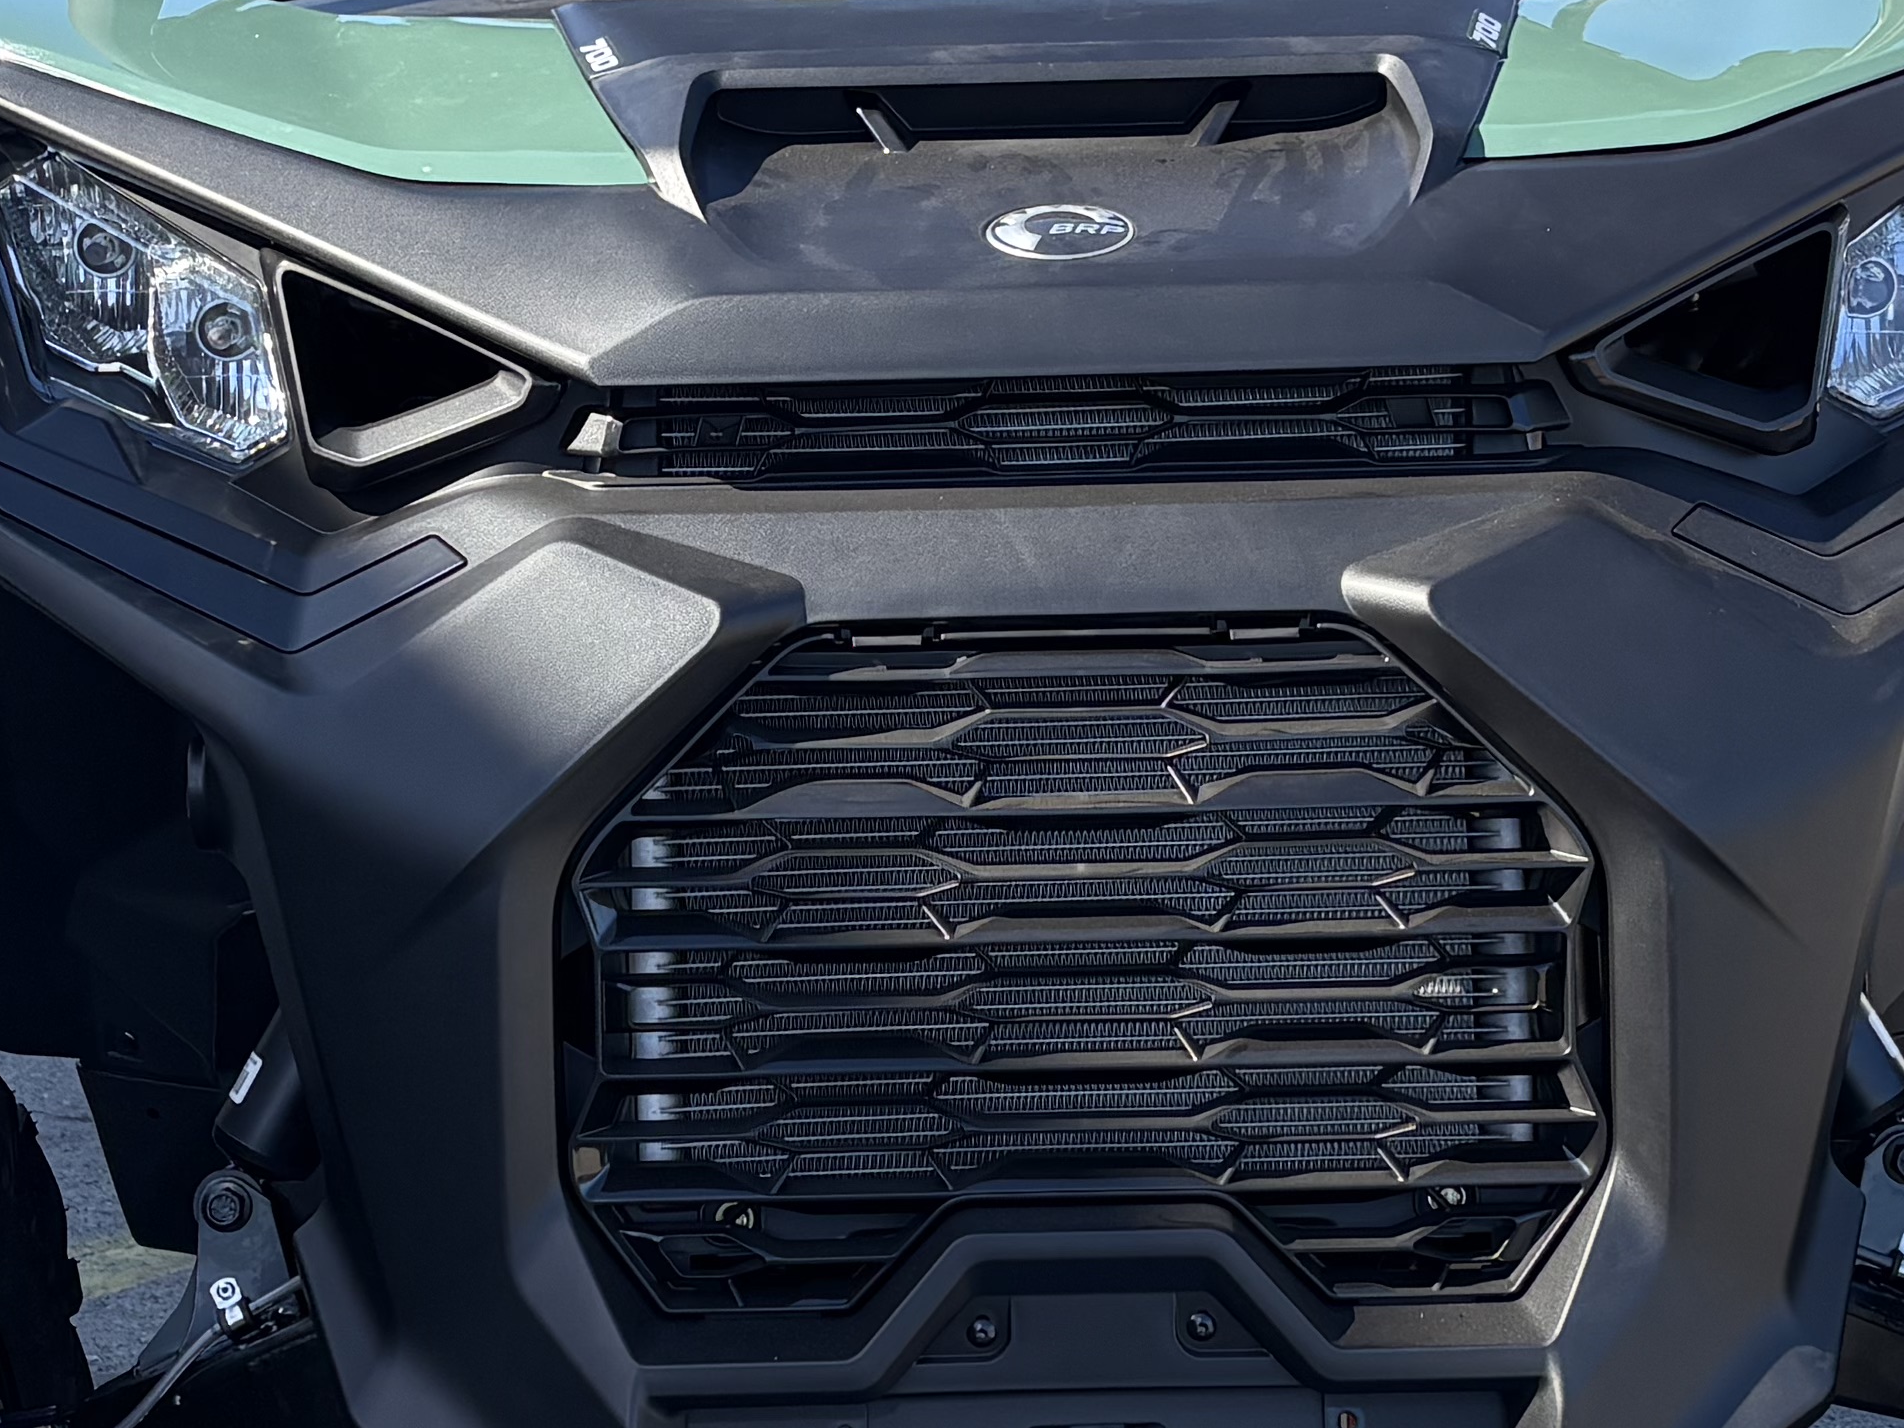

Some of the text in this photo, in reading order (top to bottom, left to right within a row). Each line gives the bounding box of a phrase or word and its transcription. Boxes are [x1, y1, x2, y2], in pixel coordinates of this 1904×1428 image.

[1472, 12, 1502, 49] 700
[579, 37, 619, 72] 700
[1048, 222, 1126, 235] BRP
